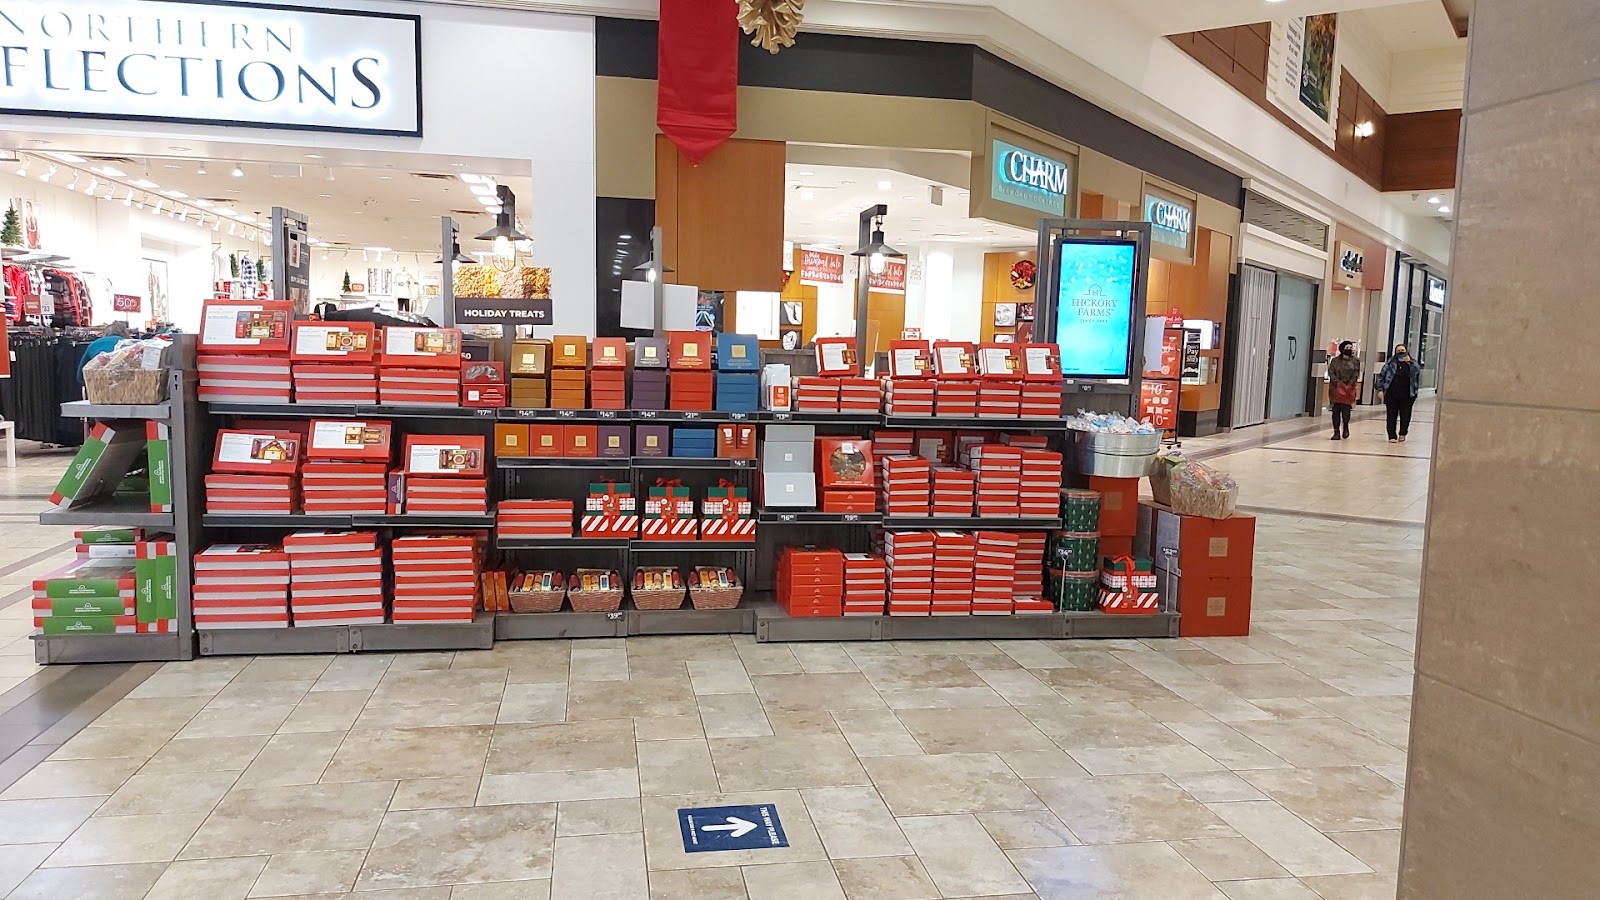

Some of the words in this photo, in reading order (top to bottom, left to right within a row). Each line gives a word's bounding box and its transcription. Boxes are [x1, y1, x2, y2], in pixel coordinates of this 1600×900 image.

[0, 45, 383, 108] FLECTIONS
[1010, 150, 1068, 195] CHARM
[1156, 201, 1191, 233] CHARM
[464, 309, 507, 318] HOLIDAY
[509, 310, 545, 318] TREATS
[1071, 298, 1118, 308] HICKORY
